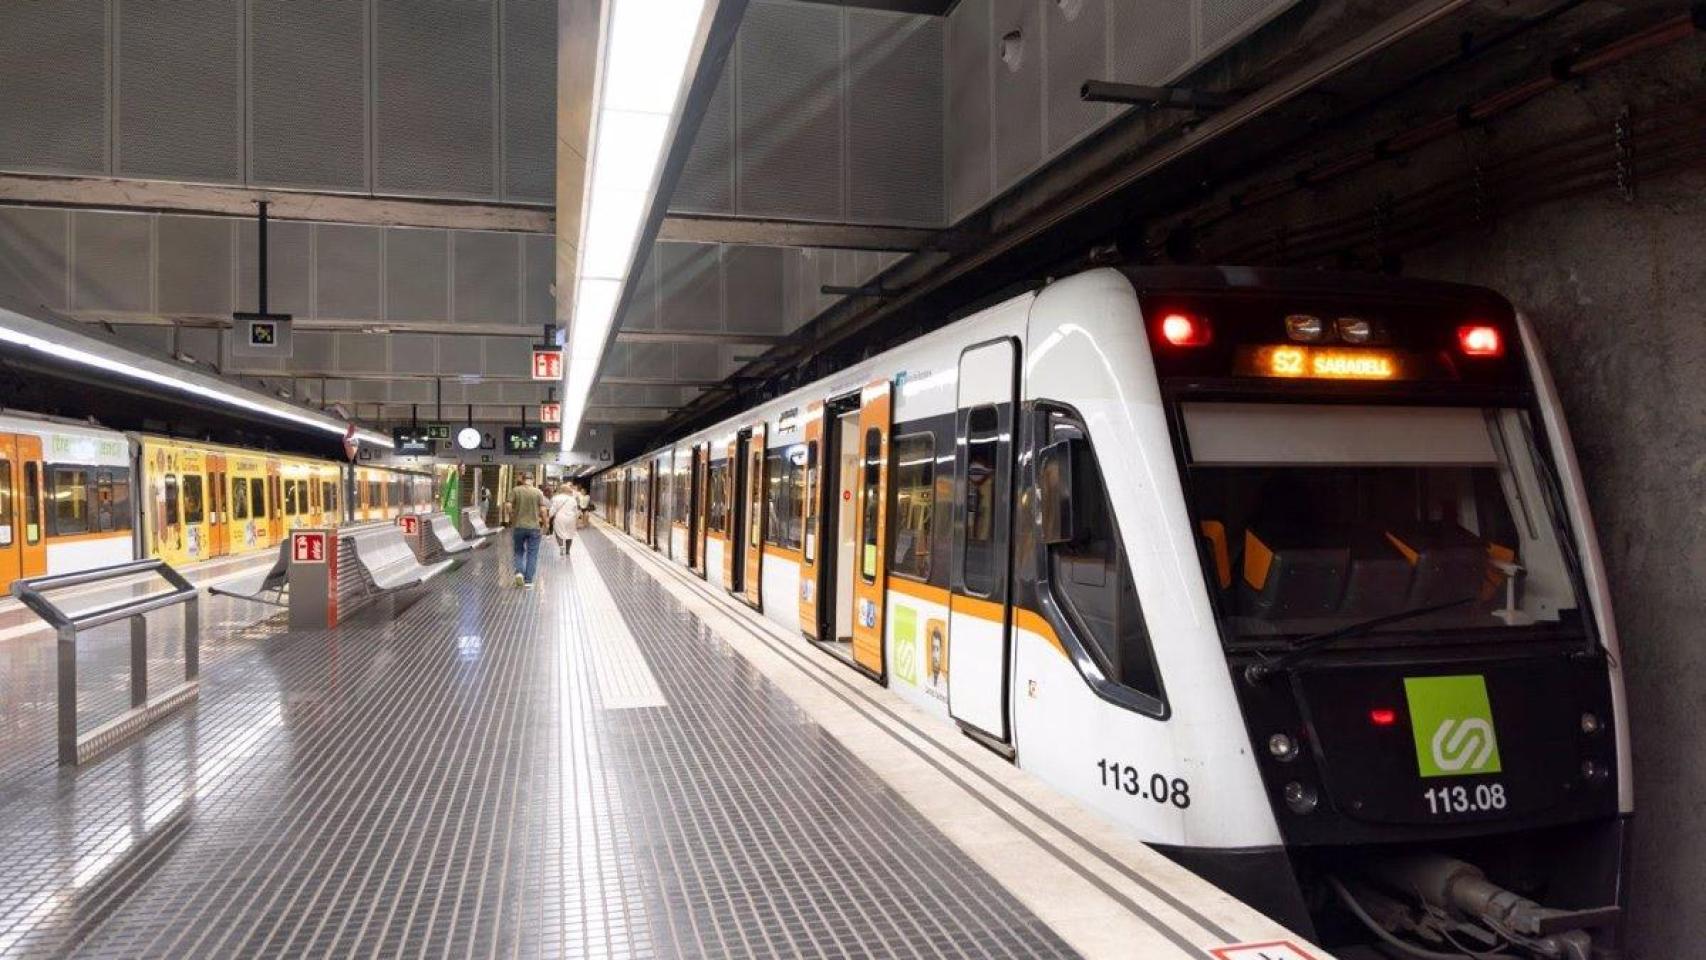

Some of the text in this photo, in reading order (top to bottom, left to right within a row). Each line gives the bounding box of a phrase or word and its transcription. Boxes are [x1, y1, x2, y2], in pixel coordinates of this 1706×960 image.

[1272, 349, 1391, 376] S2 SABADELL
[1097, 758, 1190, 809] 113.08
[1424, 784, 1506, 814] 113.08
